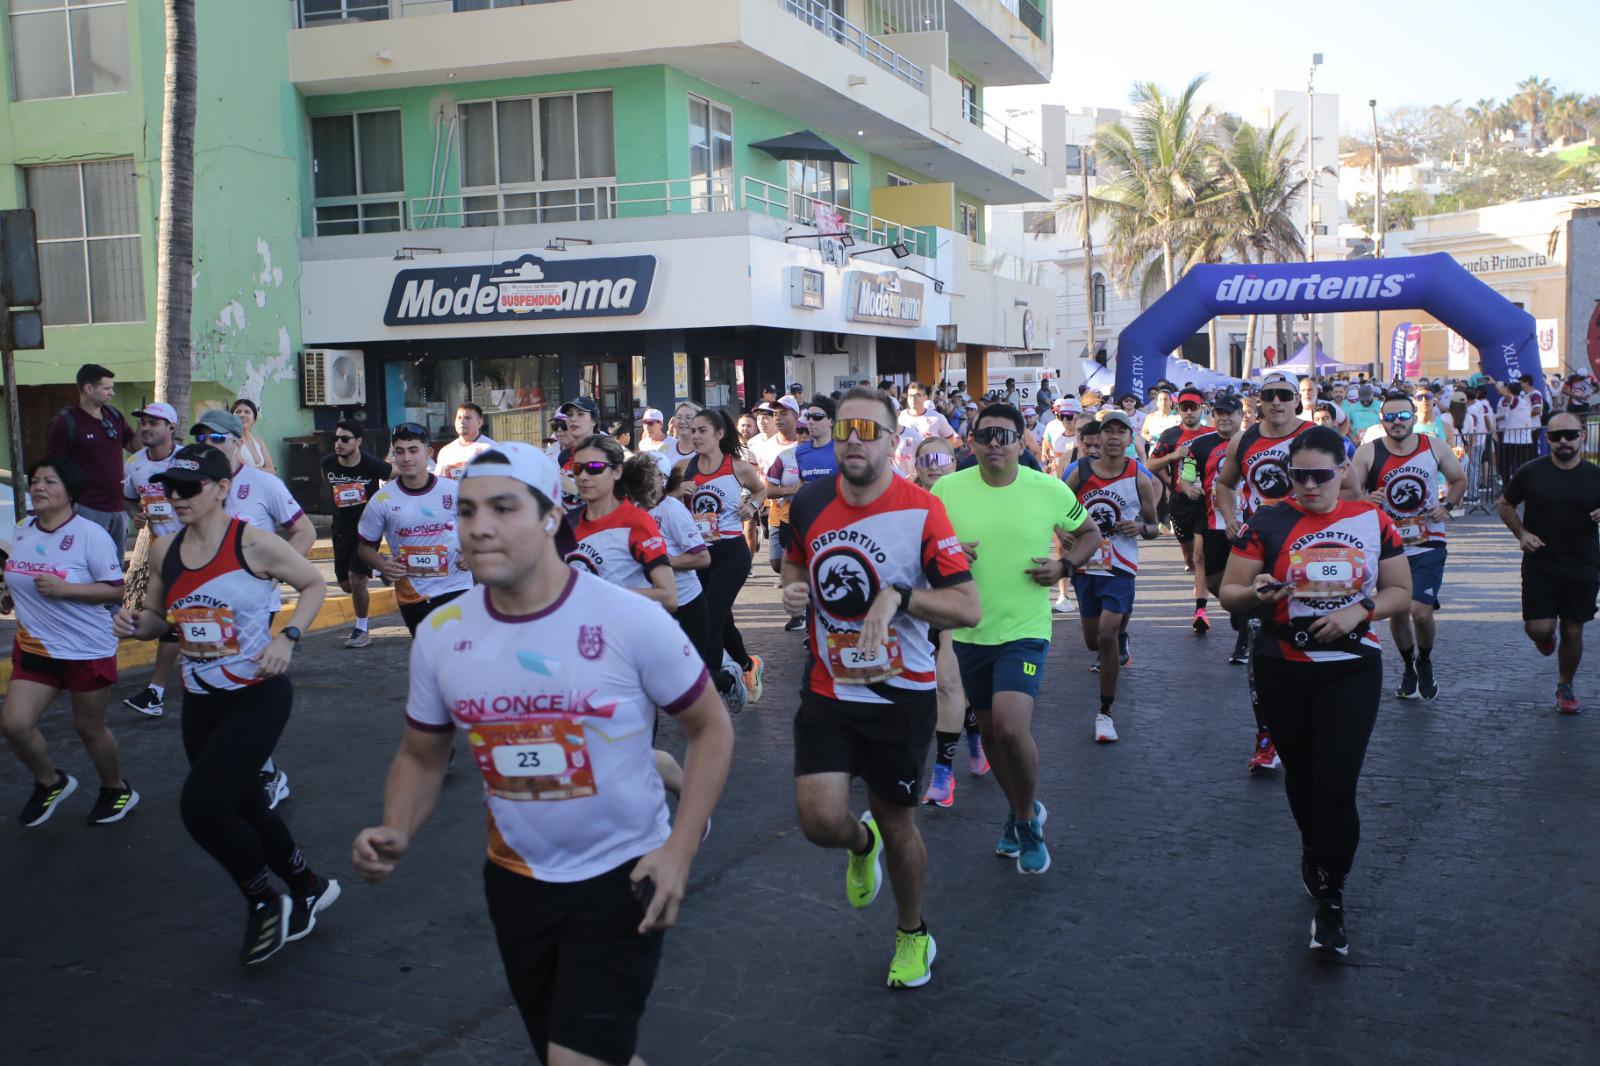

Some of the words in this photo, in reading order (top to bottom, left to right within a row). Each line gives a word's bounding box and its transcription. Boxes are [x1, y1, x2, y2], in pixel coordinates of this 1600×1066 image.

[1492, 253, 1547, 271] Primaria
[1215, 273, 1405, 304] dportenis
[501, 294, 561, 306] SUSPENDIDO
[1384, 466, 1429, 481] DEPORTIVO
[1083, 489, 1126, 507] DEPORTIVO
[812, 530, 887, 565] DEPORTIVO
[1292, 531, 1364, 551] DEPORTIVO
[416, 557, 431, 565] 140
[1322, 565, 1338, 576] 86
[191, 626, 208, 637] 64
[492, 694, 564, 713] ONCE
[516, 751, 541, 768] 23
